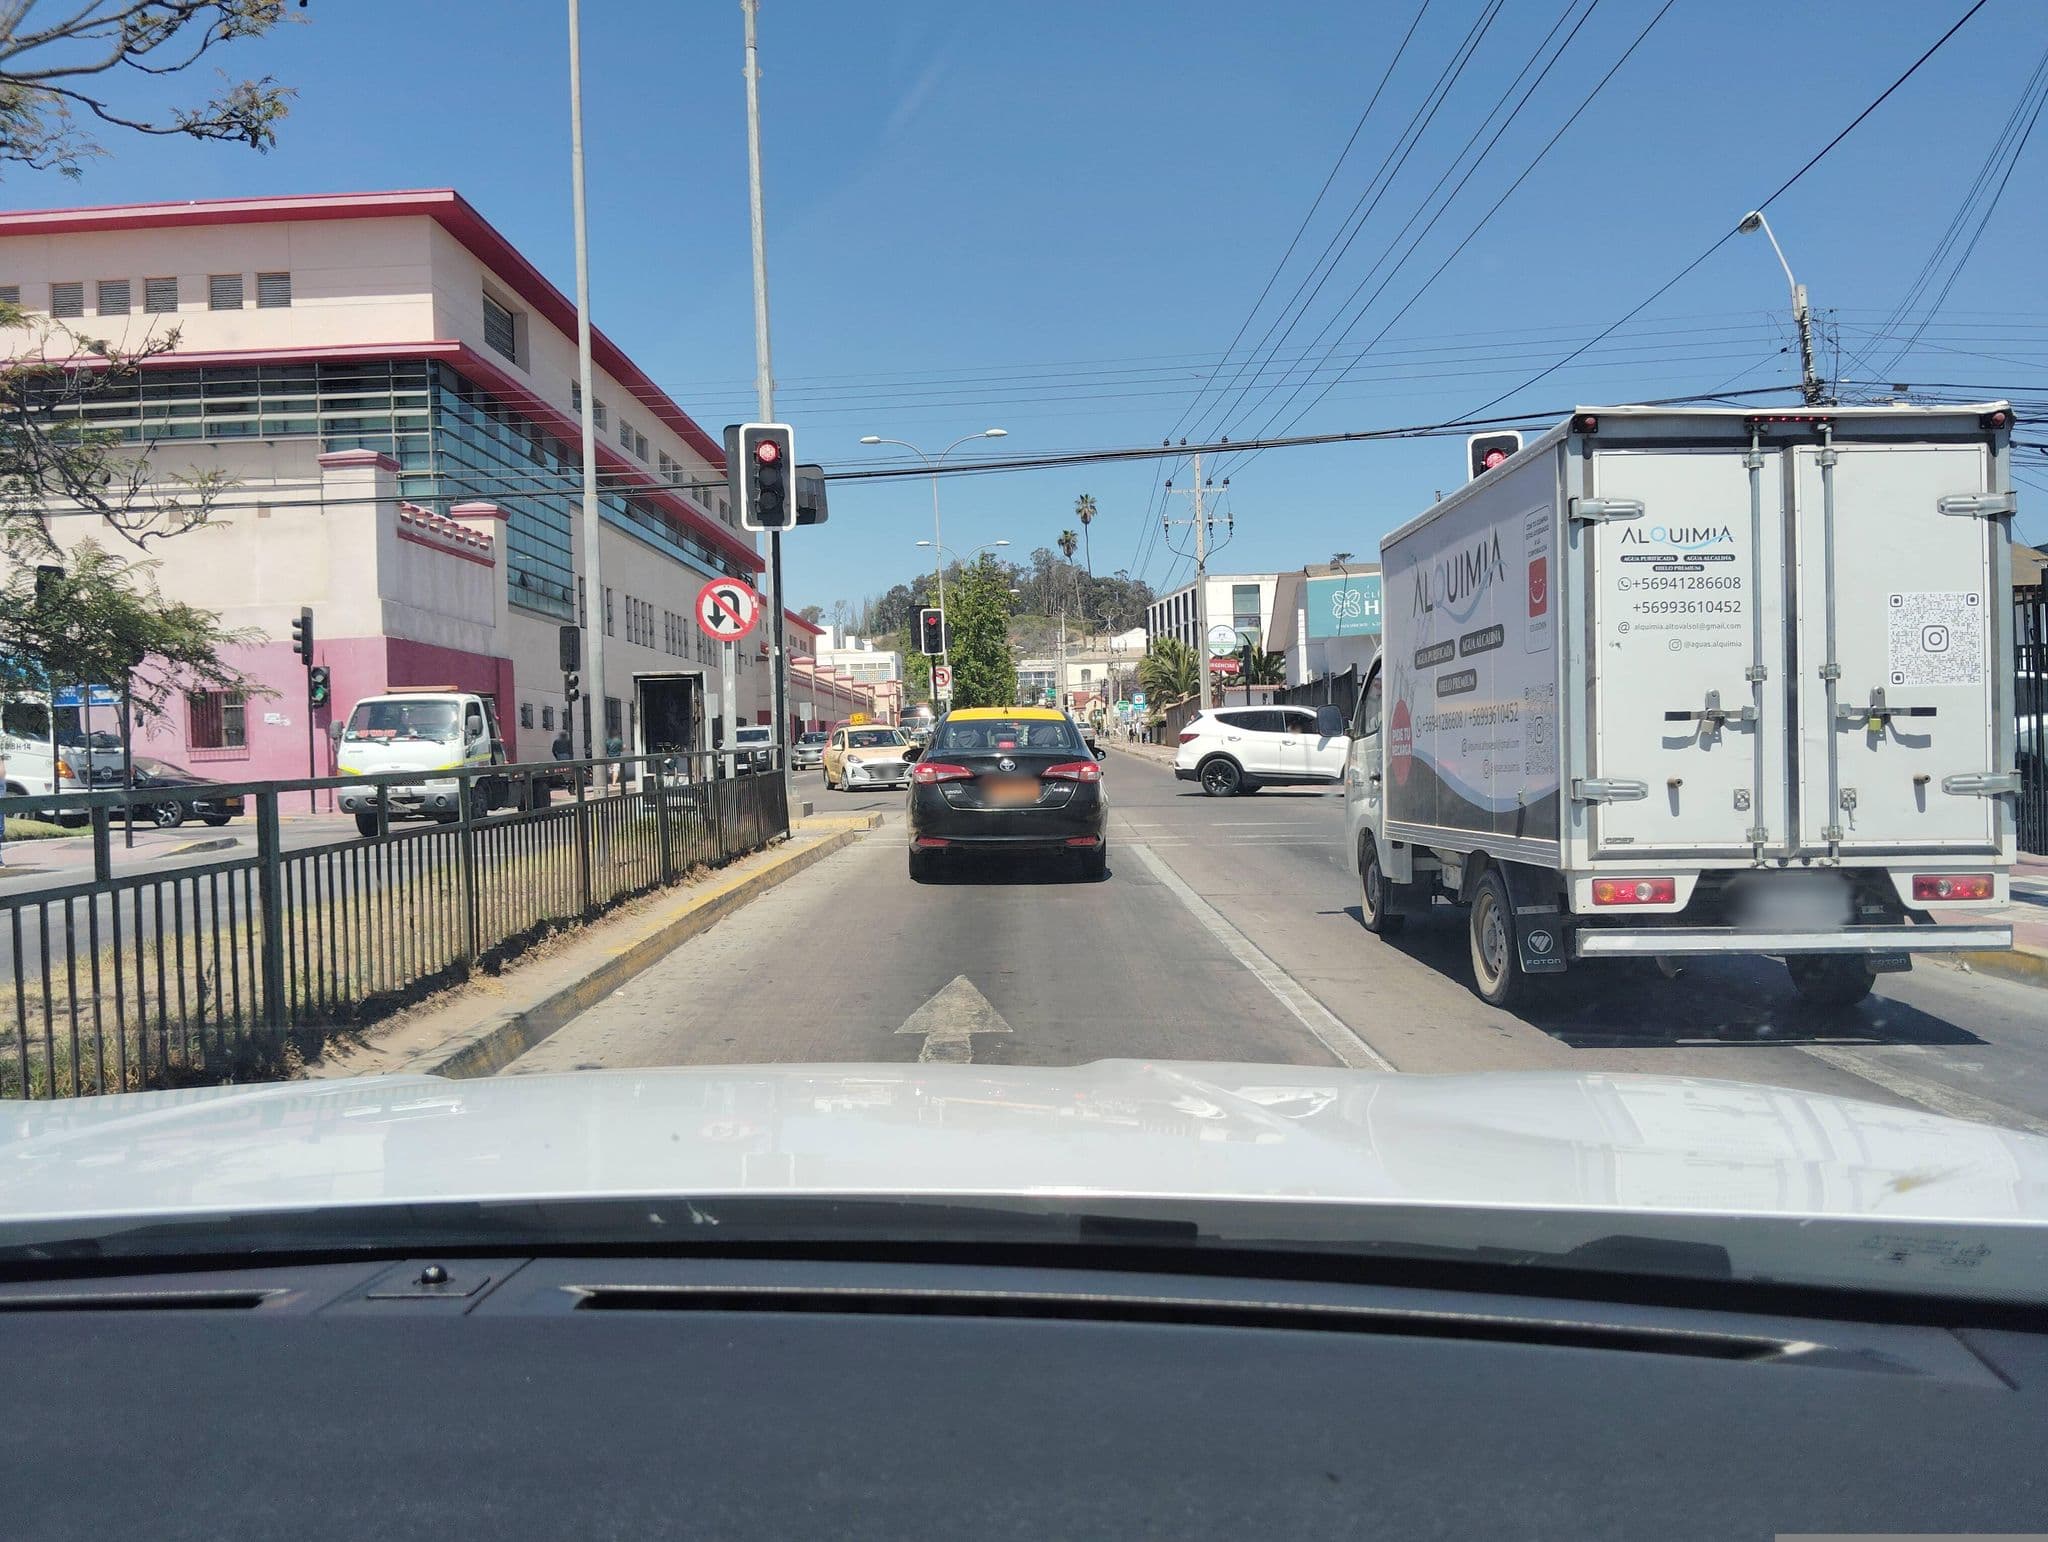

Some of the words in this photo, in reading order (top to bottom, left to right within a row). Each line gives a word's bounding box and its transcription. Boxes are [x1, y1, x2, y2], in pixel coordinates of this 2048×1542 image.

[1621, 525, 1735, 545] ALQUIMIA
[1411, 527, 1504, 618] ALQUIMIA
[1632, 577, 1741, 590] +56941286608
[1633, 600, 1741, 614] +56993610452
